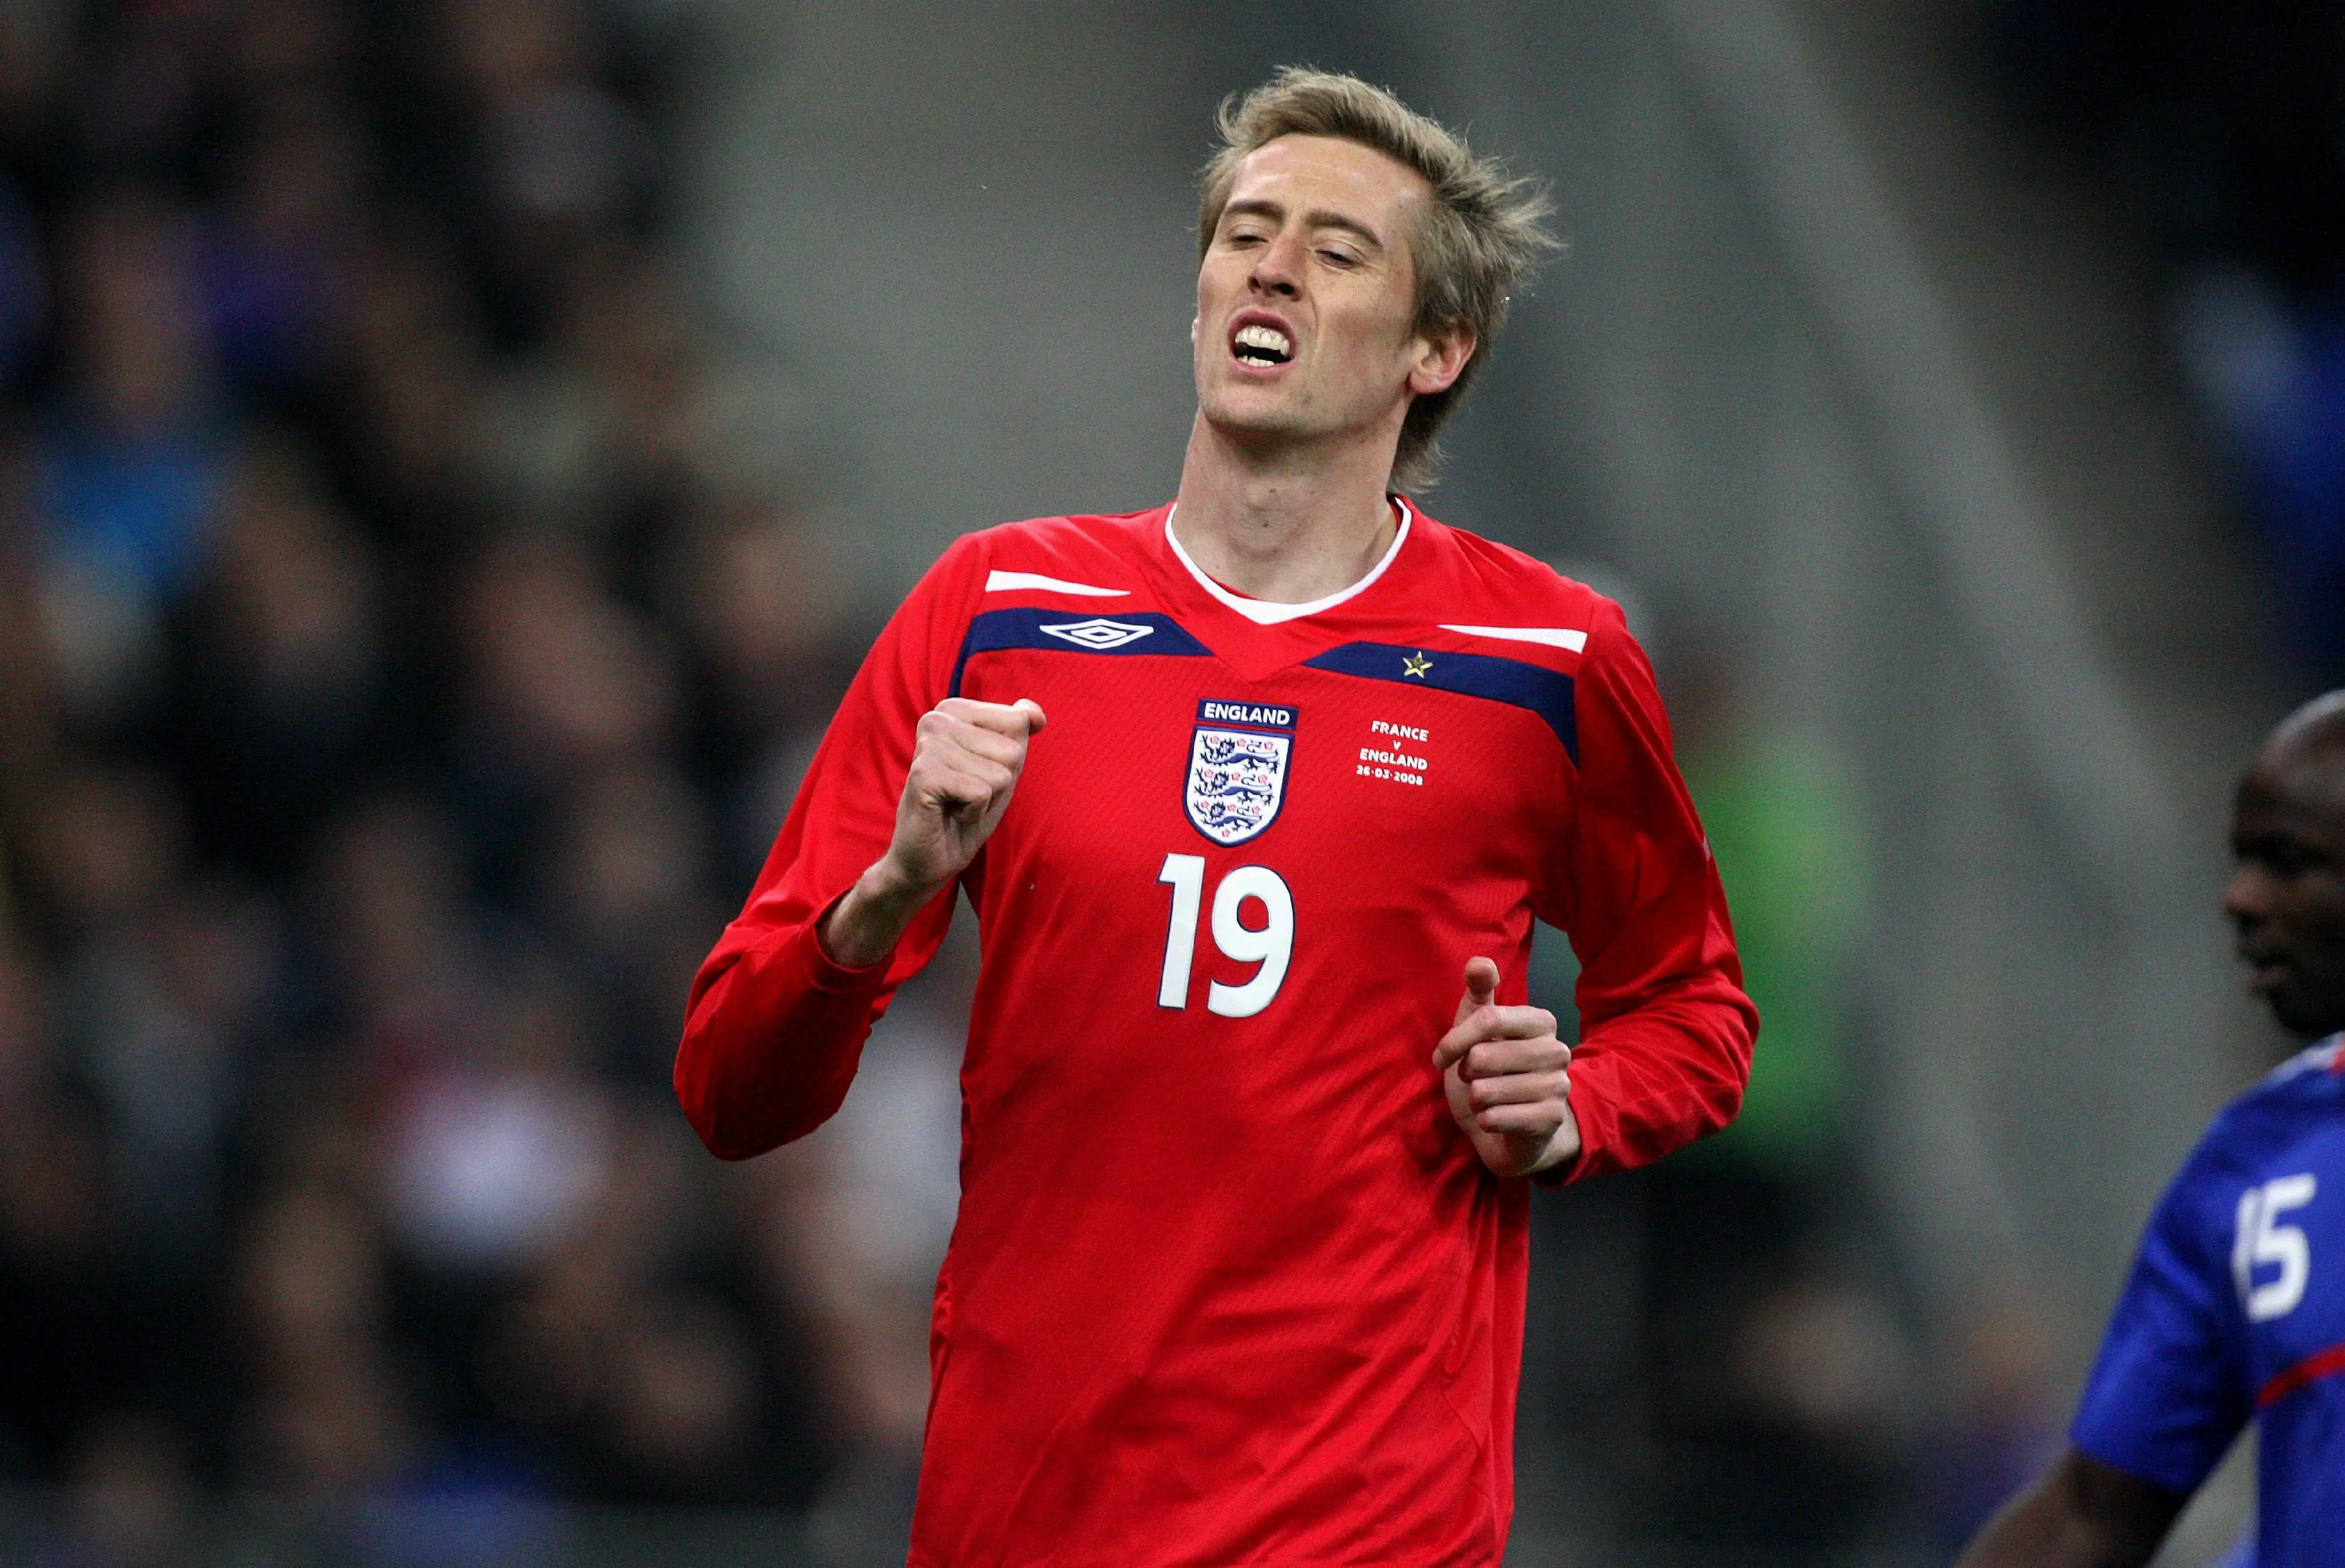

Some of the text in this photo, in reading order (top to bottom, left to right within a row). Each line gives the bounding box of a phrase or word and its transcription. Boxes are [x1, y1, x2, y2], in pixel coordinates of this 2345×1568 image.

[1204, 702, 1290, 725] ENGLAND
[1371, 720, 1429, 742] FRANCE
[1359, 748, 1427, 770] ENGLAND
[1156, 852, 1295, 1018] 19
